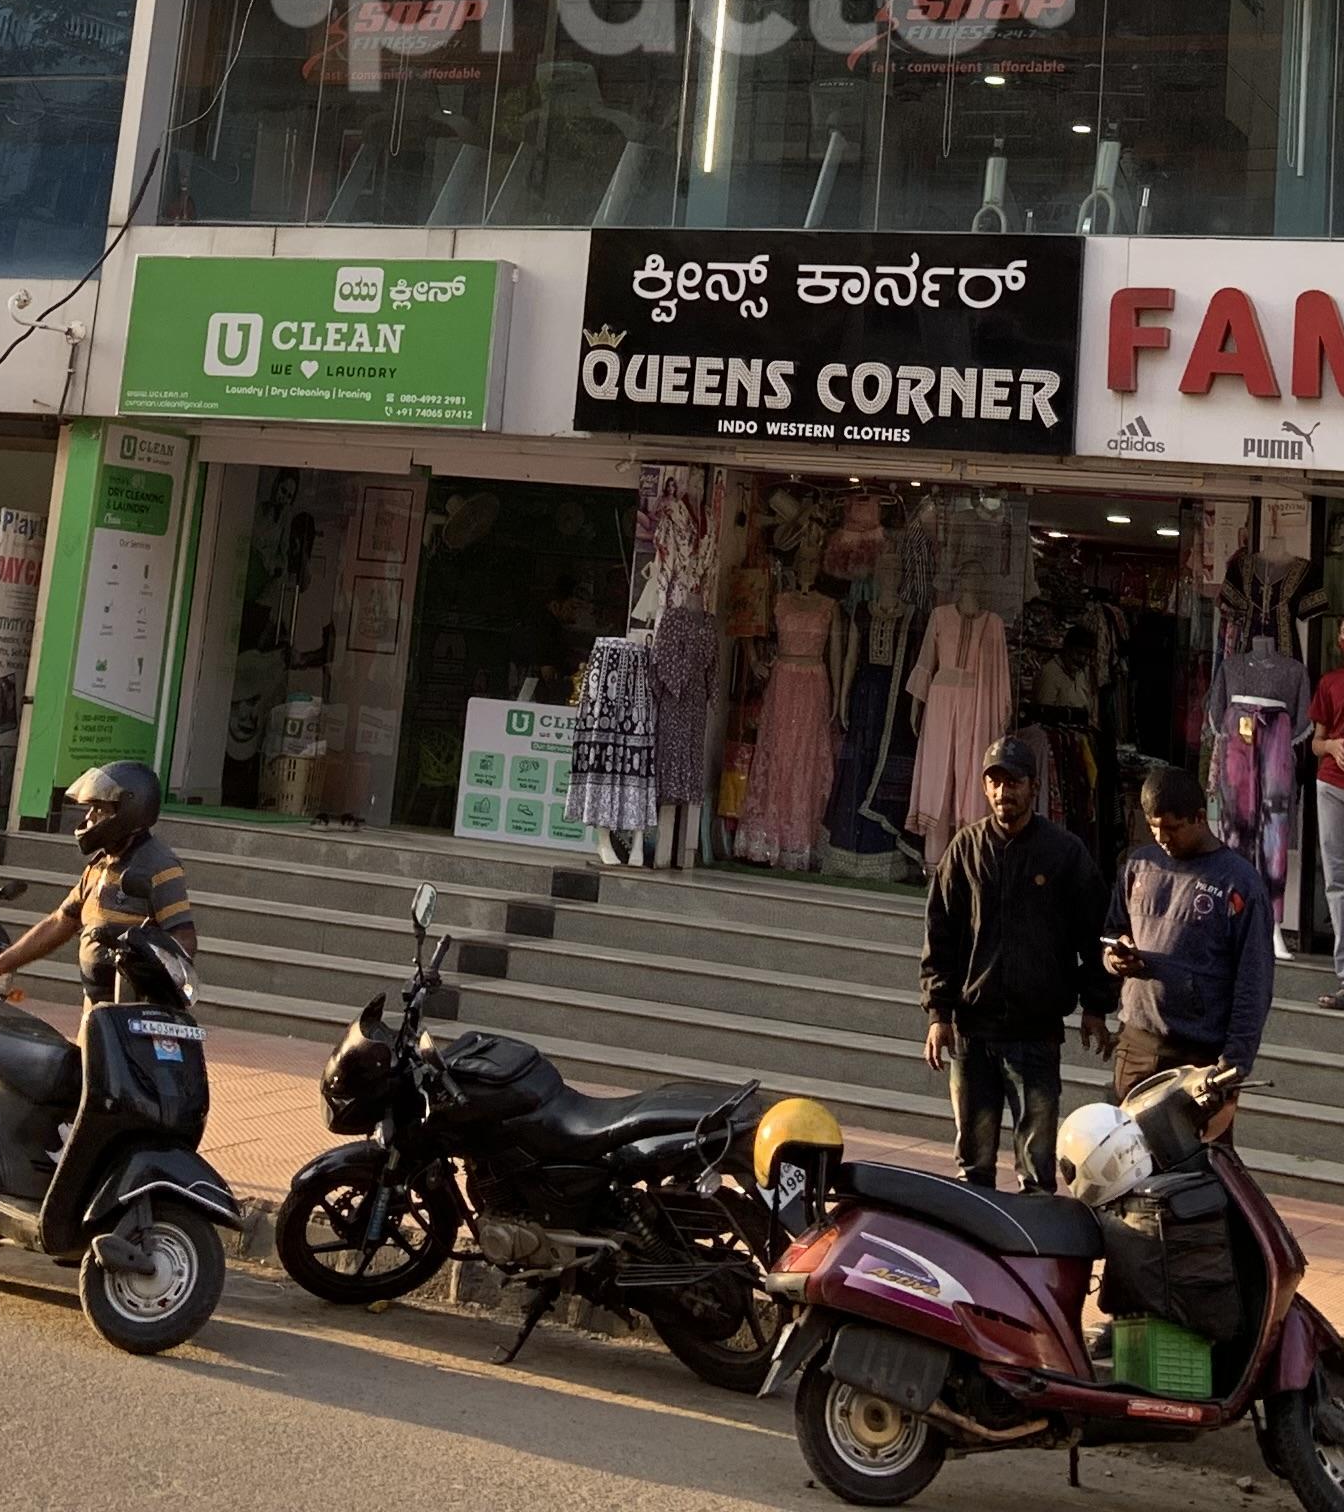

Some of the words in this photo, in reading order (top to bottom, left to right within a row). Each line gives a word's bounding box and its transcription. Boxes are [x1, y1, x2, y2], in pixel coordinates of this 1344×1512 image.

[422, 67, 481, 81] affordable
[907, 60, 982, 74] convenient
[992, 59, 1065, 74] affordable
[632, 253, 770, 323] ಕ್ವೀನ್ಸ್
[796, 251, 1029, 310] ಕಾರ್ನರ್
[272, 321, 406, 354] CLEAN
[271, 364, 293, 376] WE
[326, 366, 398, 379] LAUNDRY
[226, 384, 263, 398] Laundry
[271, 386, 288, 399] Dry
[289, 386, 331, 400] Cleaning
[338, 388, 372, 402] Ironing
[582, 348, 796, 411] QUEENS
[816, 361, 1062, 430] CORNER
[396, 407, 413, 417] +91
[717, 419, 758, 435] INDO
[766, 421, 835, 439] WESTERN
[844, 424, 911, 442] CLOTHES
[139, 440, 175, 456] CLEAN
[1107, 435, 1166, 454] adidas
[1243, 437, 1303, 461] PUMA
[539, 715, 578, 730] CLE
